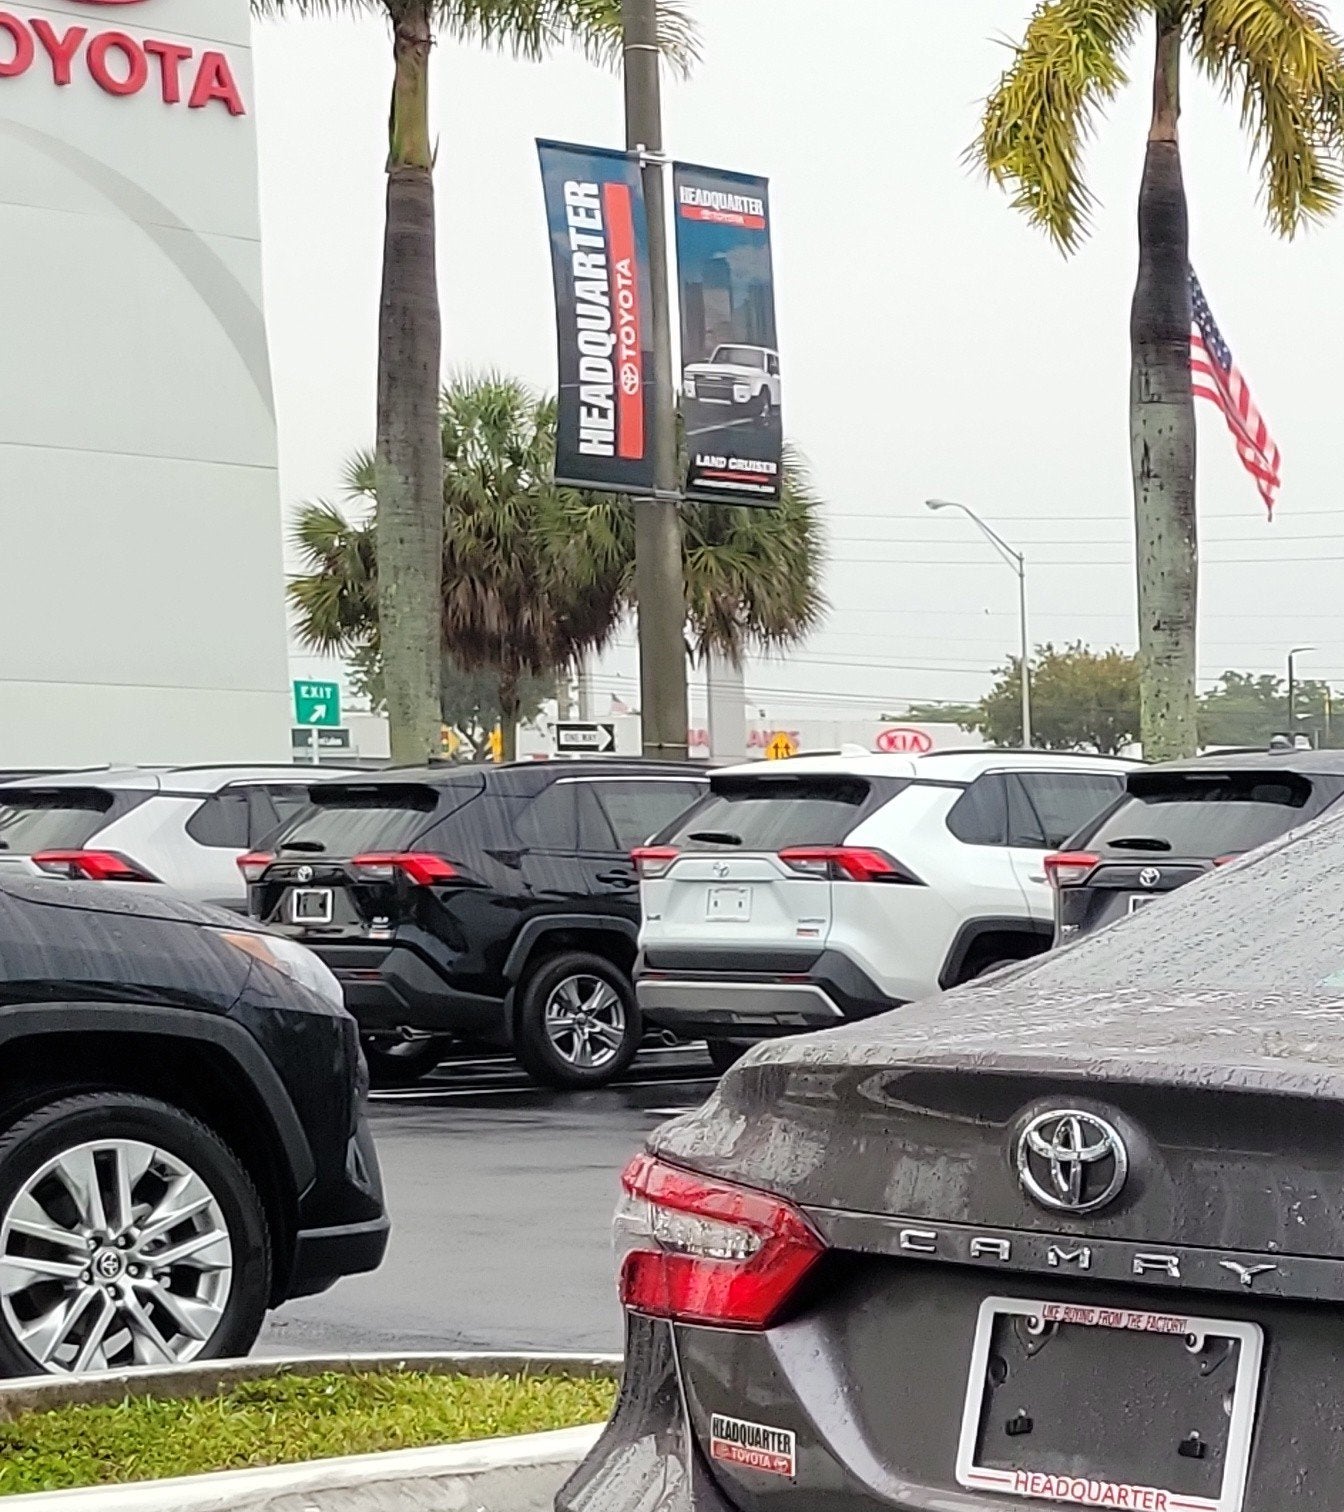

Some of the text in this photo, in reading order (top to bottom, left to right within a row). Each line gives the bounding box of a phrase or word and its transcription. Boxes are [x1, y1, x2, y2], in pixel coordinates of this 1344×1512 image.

[679, 185, 764, 216] HEADQUARTER
[564, 180, 616, 457] HEADQUARTER
[616, 258, 637, 360] TOYOTA
[695, 453, 778, 475] LAND CRUISER
[300, 686, 332, 699] EXIT
[886, 735, 923, 751] KIA
[900, 1229, 1277, 1286] CAMRY
[1042, 1304, 1060, 1320] LIKE
[1063, 1306, 1095, 1324] BUYING
[1100, 1310, 1123, 1326] FROM
[1127, 1313, 1143, 1329] THE
[713, 1417, 791, 1454] HEADQUARTER
[731, 1447, 772, 1468] TOYOTA
[1014, 1470, 1167, 1511] HEADQUARTER
